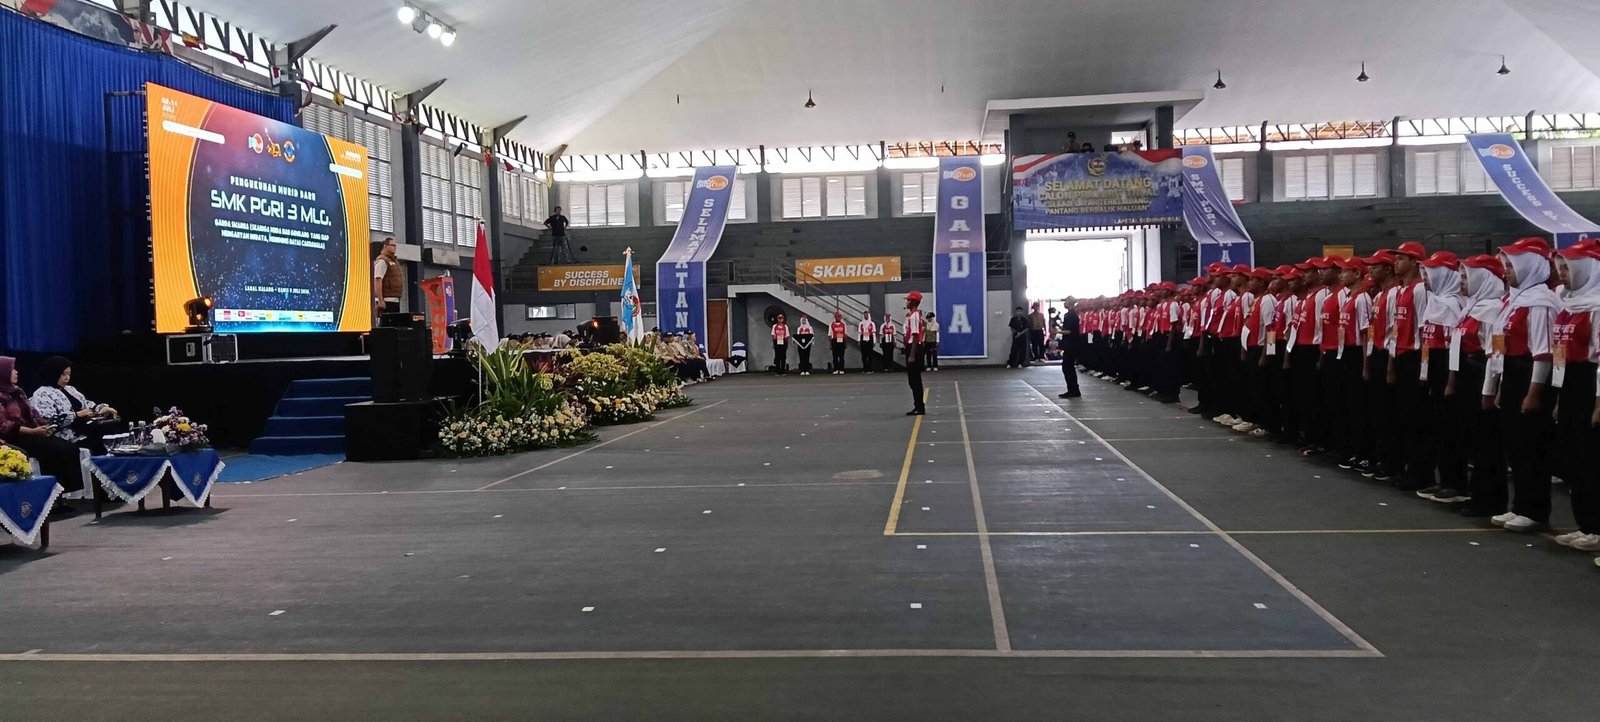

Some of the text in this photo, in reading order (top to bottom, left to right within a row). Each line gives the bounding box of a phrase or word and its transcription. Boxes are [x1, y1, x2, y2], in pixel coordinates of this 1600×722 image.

[230, 175, 316, 201] PENGUKUHAN MURID BARU
[1045, 177, 1151, 191] SELAMAT DATANG
[1039, 190, 1073, 201] CALON
[211, 189, 332, 226] SMK PGRI 3 MLG.
[813, 264, 885, 279] SKARIGA
[948, 196, 973, 333] GARDA
[565, 271, 609, 279] SUCCESS
[554, 278, 624, 287] BY DISCIPLINE
